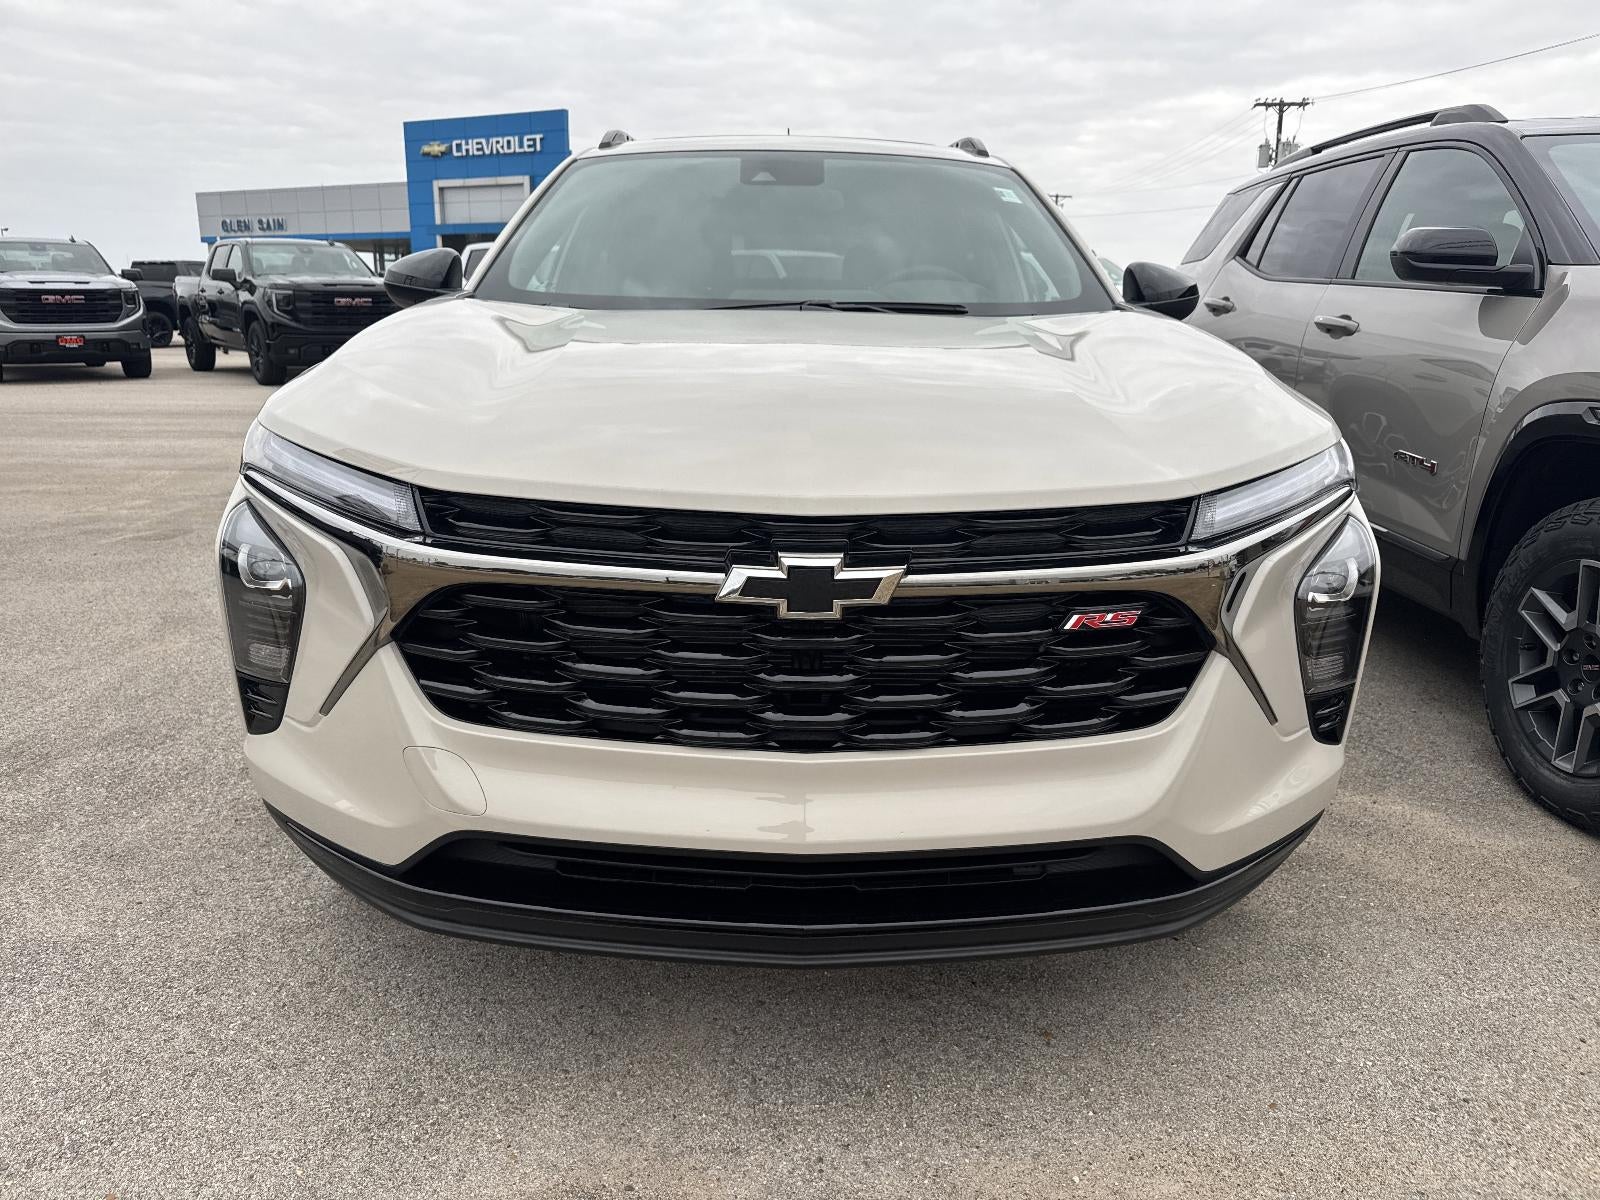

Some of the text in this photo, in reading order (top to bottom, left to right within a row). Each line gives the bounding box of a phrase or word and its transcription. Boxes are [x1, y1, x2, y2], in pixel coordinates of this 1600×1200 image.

[452, 134, 543, 157] CHEVROLET
[221, 217, 285, 233] GLEN SAIN
[41, 294, 86, 304] GMC
[334, 297, 373, 306] GMC
[1063, 610, 1142, 630] RS
